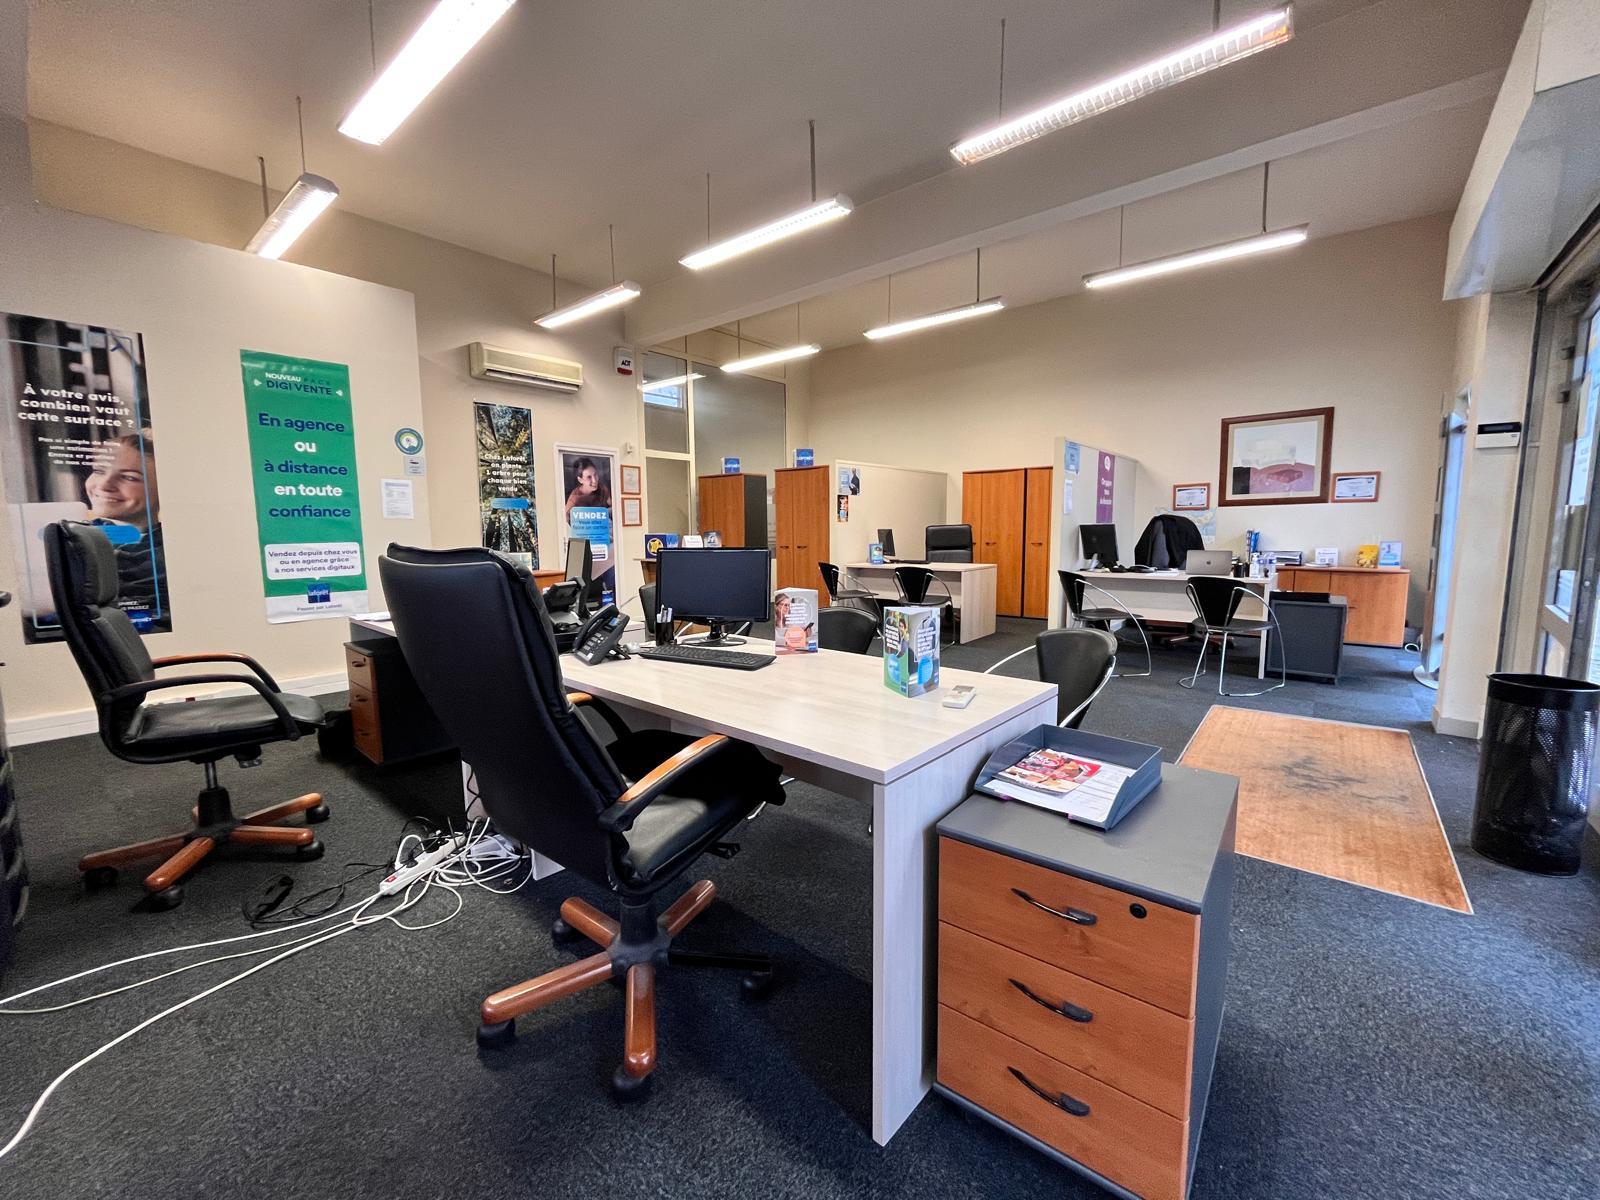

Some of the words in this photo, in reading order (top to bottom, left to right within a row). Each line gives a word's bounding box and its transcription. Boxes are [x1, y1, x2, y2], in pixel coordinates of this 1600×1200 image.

[265, 372, 301, 382] NOUVEAU
[24, 382, 36, 395] À
[40, 388, 83, 400] votre
[88, 393, 124, 405] avis,
[266, 380, 292, 390] DIGI
[295, 384, 332, 395] VENTE
[20, 399, 91, 412] combien
[96, 406, 130, 416] vaut
[18, 412, 59, 422] cette
[64, 415, 122, 427] surface
[126, 420, 134, 429] ?
[258, 412, 280, 427] En
[284, 418, 345, 432] agence
[294, 442, 316, 452] ou
[264, 460, 274, 472] à
[278, 460, 348, 475] distance
[274, 485, 296, 496] en
[298, 484, 343, 496] toute
[269, 505, 351, 518] confiance
